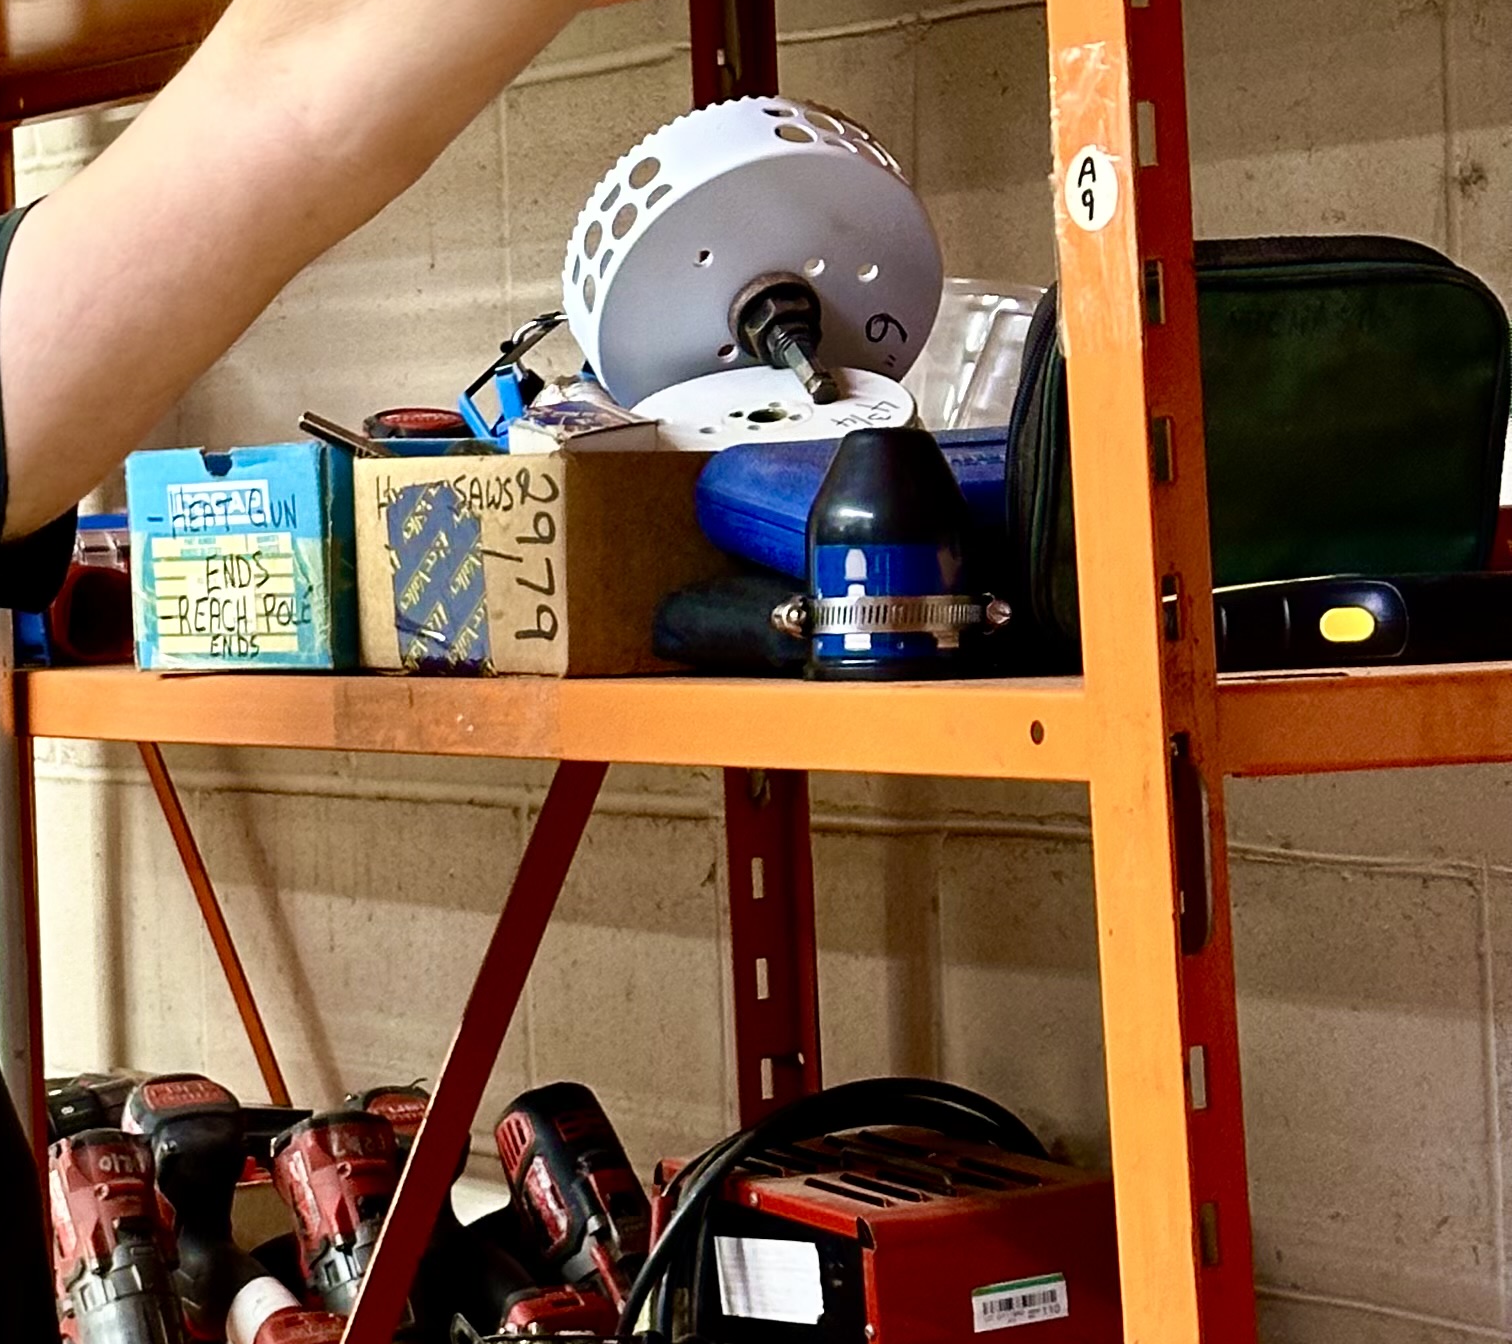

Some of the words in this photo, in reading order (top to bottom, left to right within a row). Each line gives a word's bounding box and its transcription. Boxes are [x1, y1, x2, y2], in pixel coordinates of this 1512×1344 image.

[1077, 156, 1096, 188] A
[1081, 188, 1095, 221] 9
[248, 488, 298, 529] GUN
[206, 550, 270, 594] ENDS
[210, 634, 260, 657] ENDS
